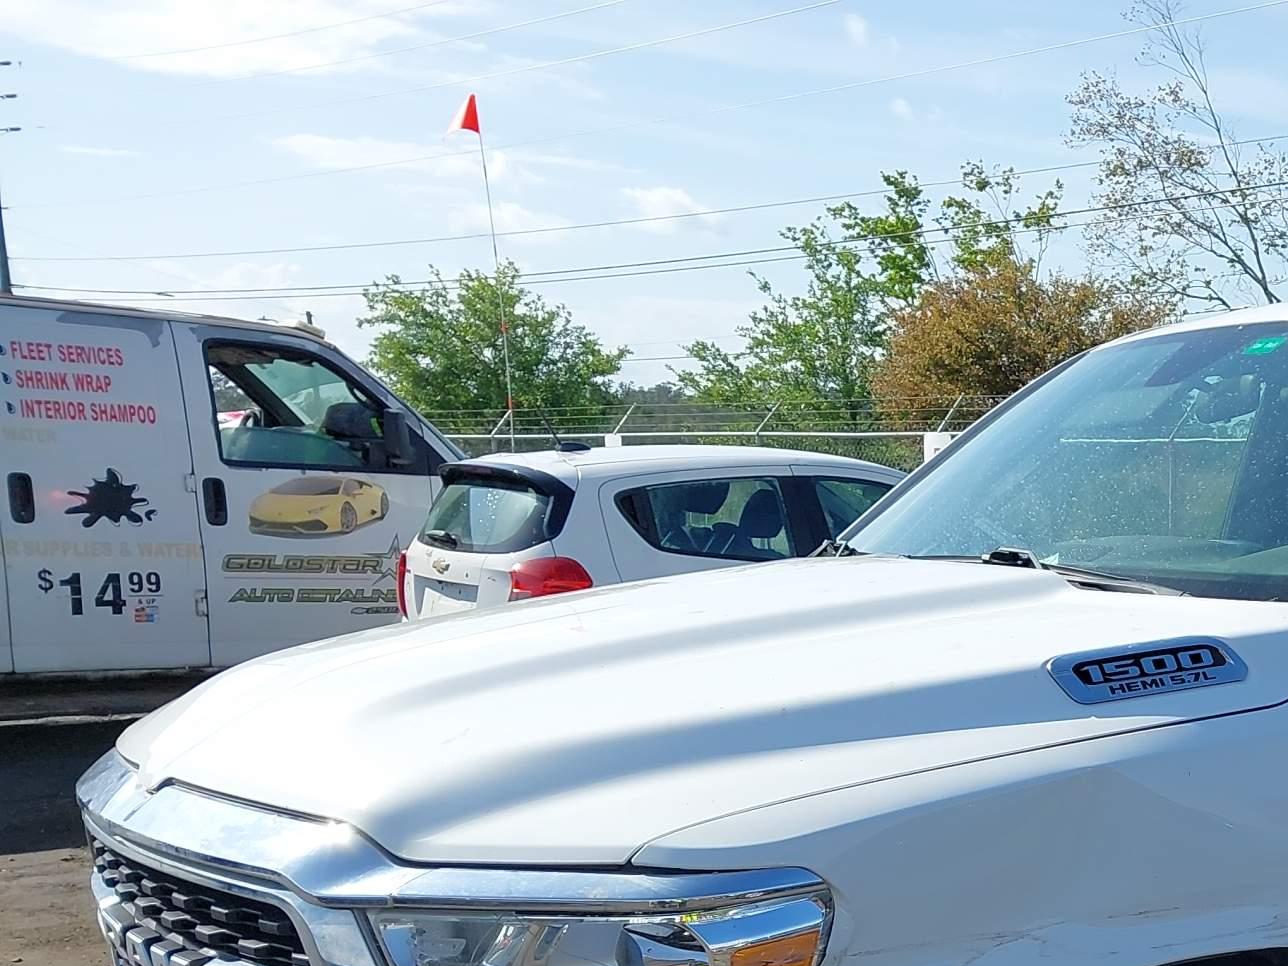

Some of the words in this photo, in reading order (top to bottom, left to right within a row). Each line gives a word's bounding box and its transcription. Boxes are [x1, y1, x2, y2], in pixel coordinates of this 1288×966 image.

[10, 341, 52, 361] FLEET
[57, 344, 124, 366] SERVICES
[15, 370, 70, 391] SHRINK
[72, 373, 112, 393] WRAP
[20, 399, 87, 421] INTERIOR
[90, 402, 157, 424] SHAMPOO
[228, 588, 295, 603] AUTO
[1080, 648, 1215, 684] 1500
[1108, 678, 1165, 696] HEMI
[1169, 671, 1217, 686] 5.7L
